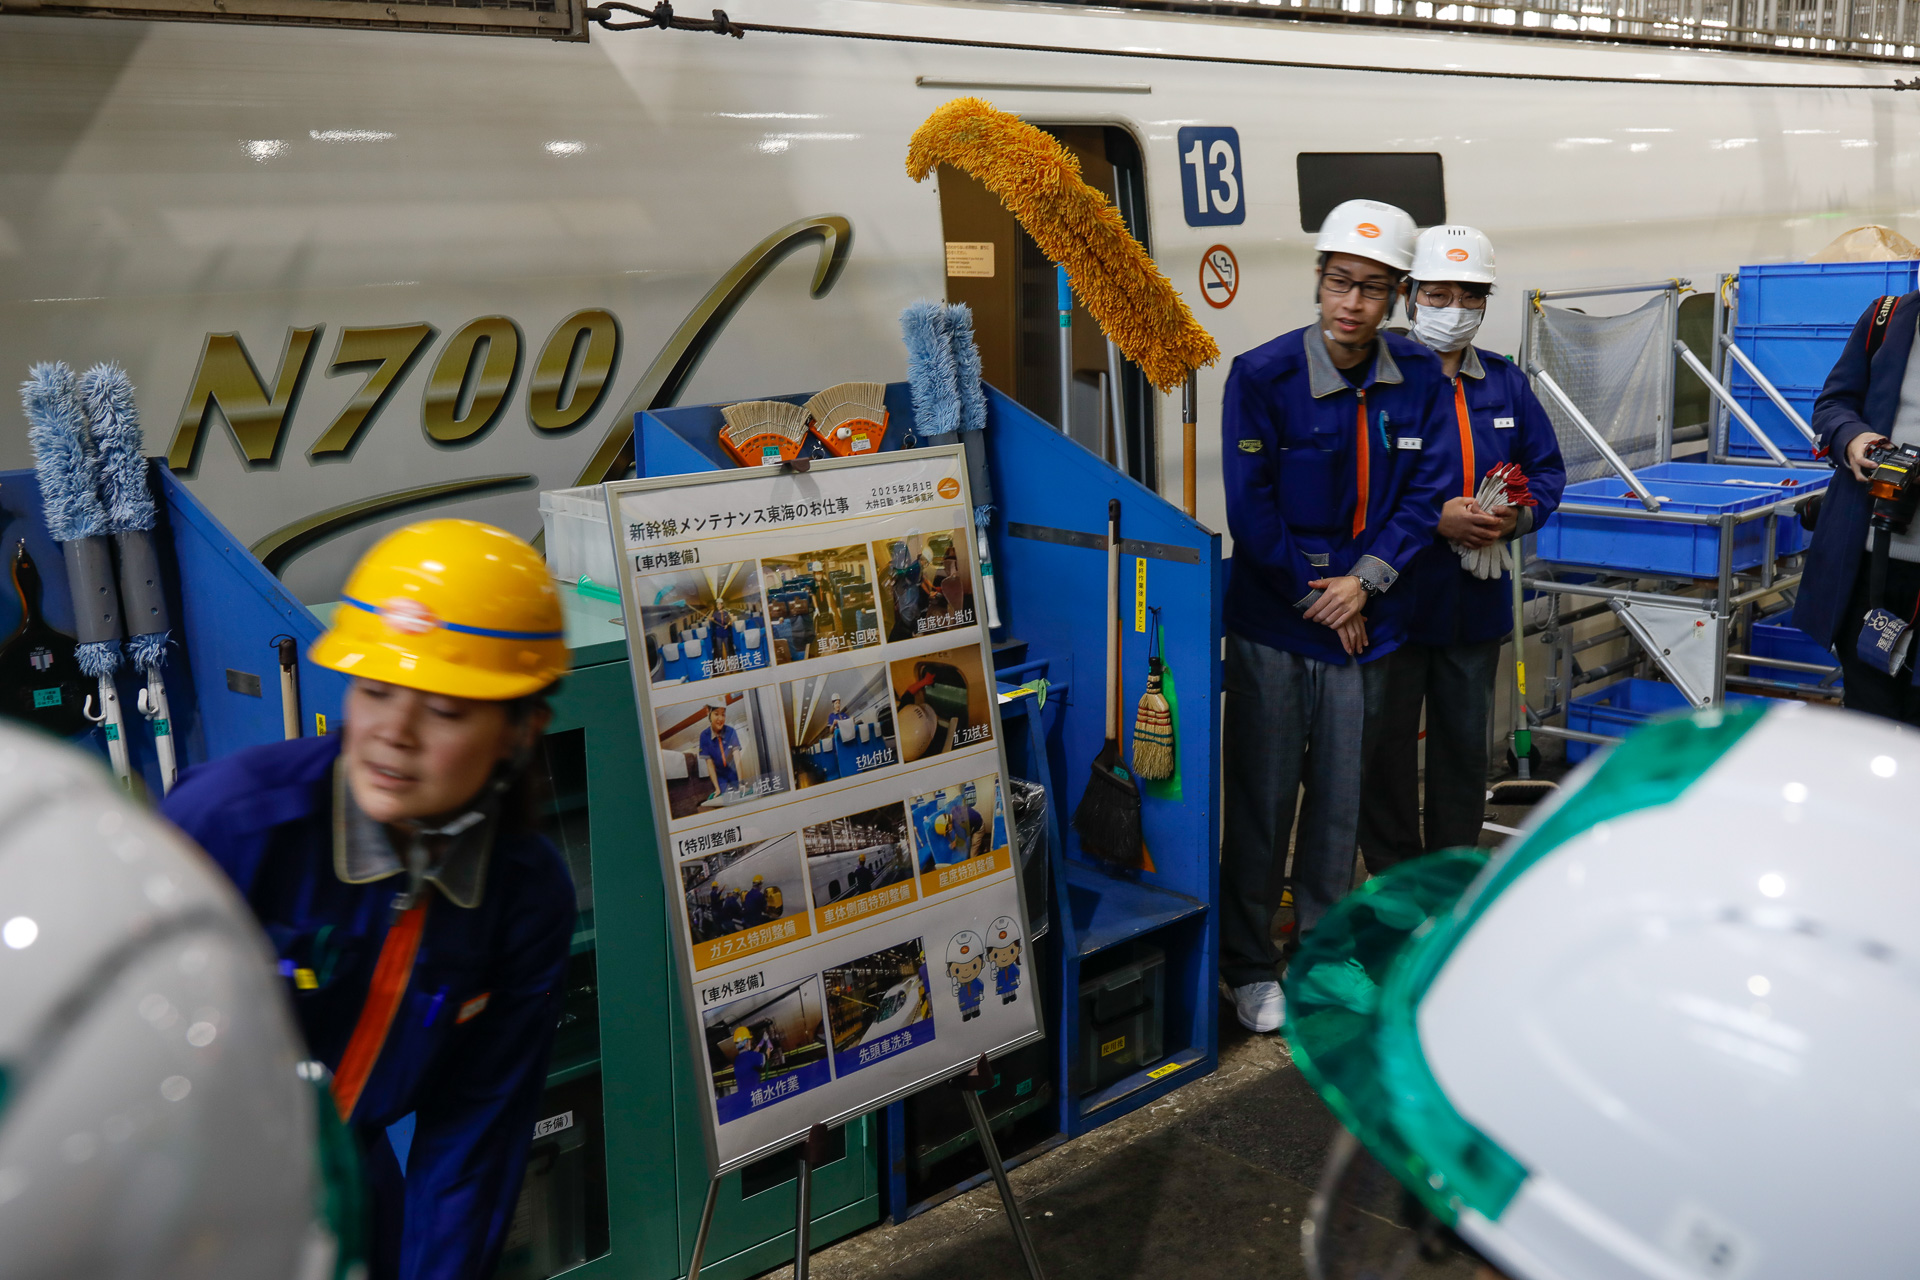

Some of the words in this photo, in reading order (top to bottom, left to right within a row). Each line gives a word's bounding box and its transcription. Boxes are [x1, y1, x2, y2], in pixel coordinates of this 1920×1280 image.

[1184, 139, 1239, 215] 13
[165, 307, 624, 480] N700
[871, 480, 932, 497] 2025年2月1日
[629, 496, 850, 542] 新幹線メンテナンス東海のお仕事
[634, 547, 701, 573] 【車内整備】
[700, 650, 765, 677] 荷物棚拭き
[677, 825, 743, 857] 【特別整備】
[938, 855, 996, 887] 座席特別整備
[823, 884, 911, 925] 車体側面特別整備
[709, 919, 797, 960] ガラス特別整備
[701, 971, 766, 1006] 【車外整備】
[859, 1030, 913, 1064] 先頭車洗浄
[750, 1074, 800, 1107] 補水作業
